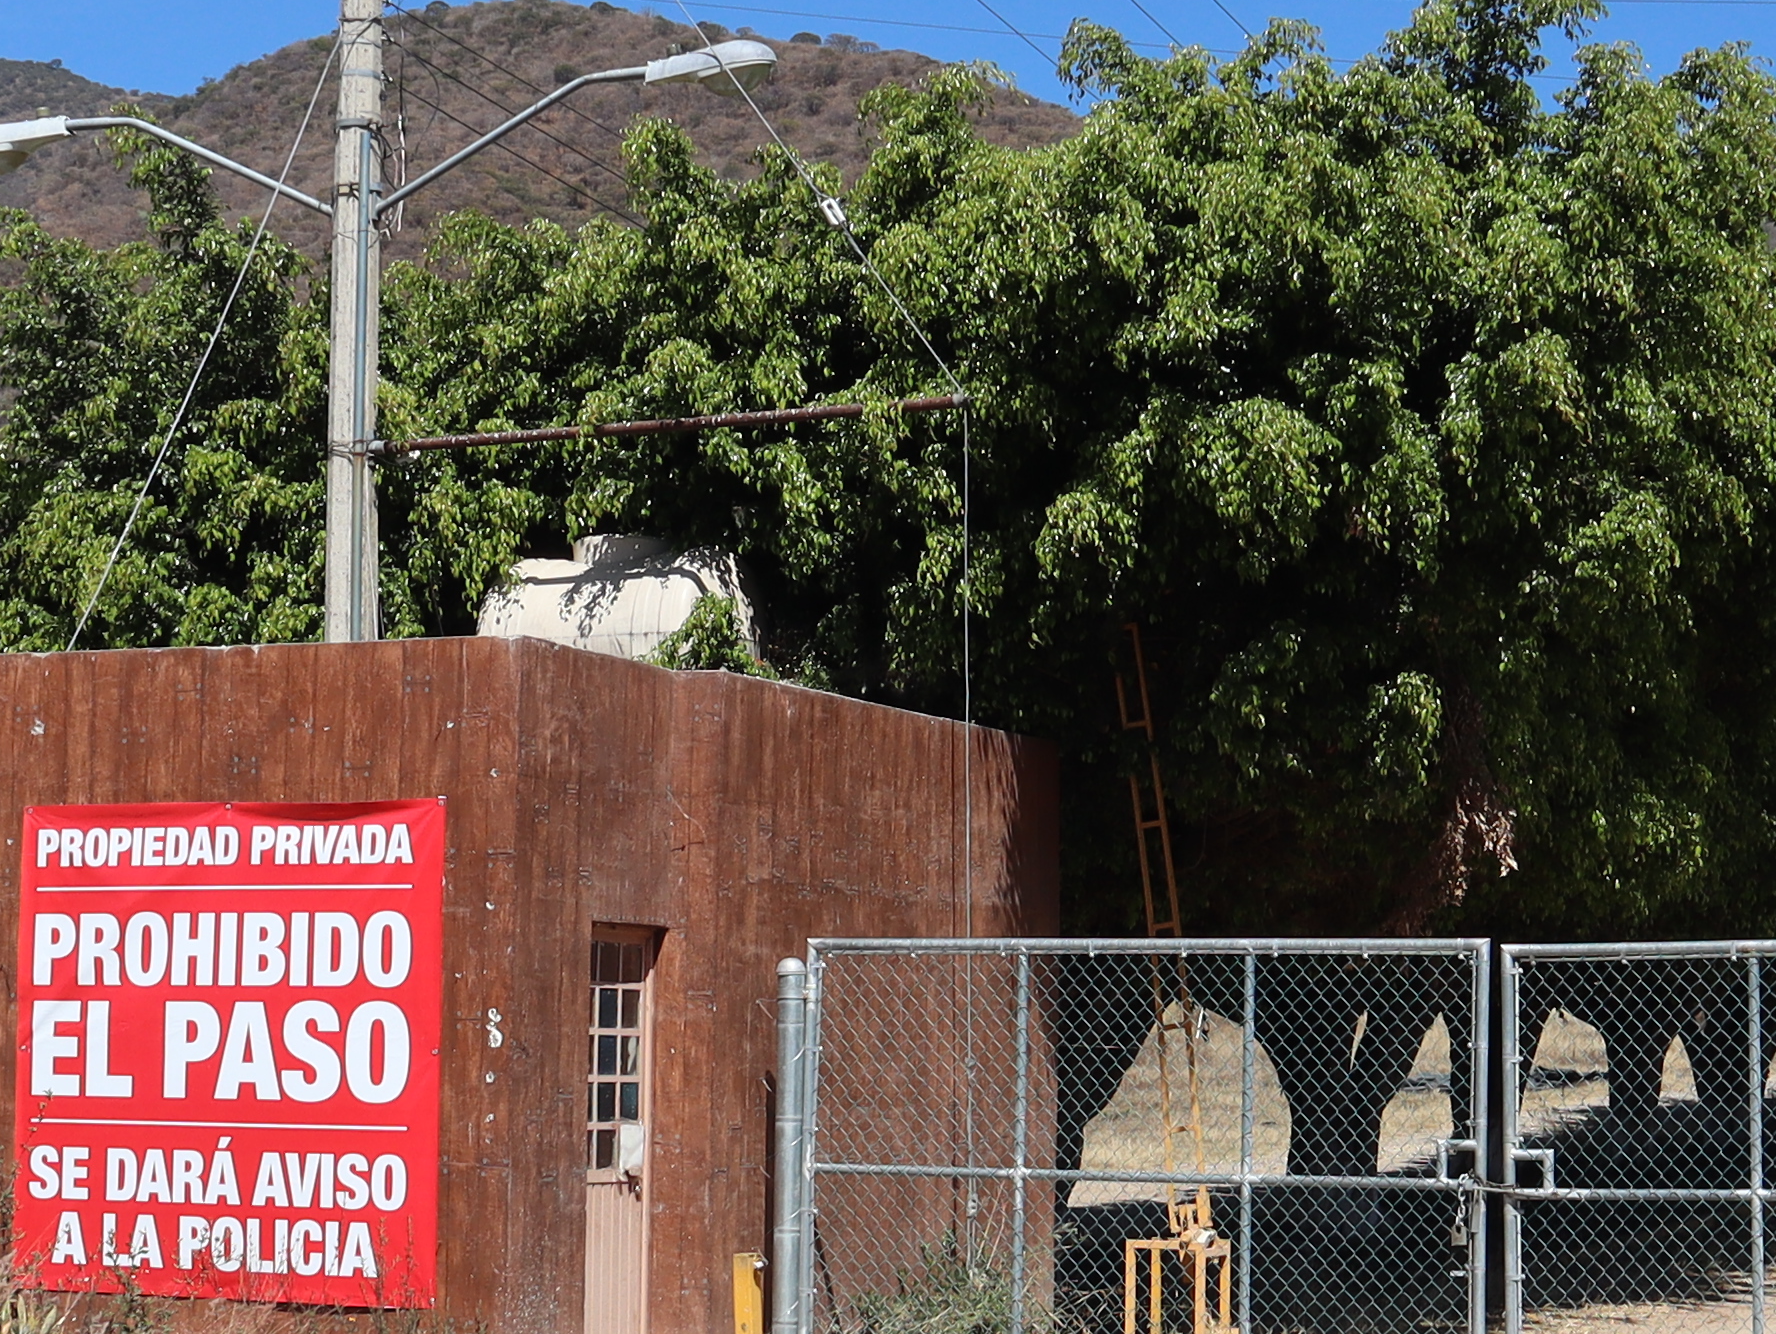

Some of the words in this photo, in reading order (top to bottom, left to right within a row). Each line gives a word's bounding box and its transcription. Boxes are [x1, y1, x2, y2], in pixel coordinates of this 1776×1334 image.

[36, 825, 239, 868] PROPIEDAD
[249, 823, 414, 866] PRIVADA
[32, 910, 412, 988] PROHIBIDO
[31, 1000, 133, 1098] EL
[163, 1000, 410, 1104] PASO
[28, 1144, 90, 1201] SE
[105, 1136, 241, 1206] DARÁ
[251, 1151, 407, 1212] AVISO
[50, 1211, 88, 1266] A
[102, 1212, 164, 1269] LA
[177, 1215, 379, 1279] POLICIA
